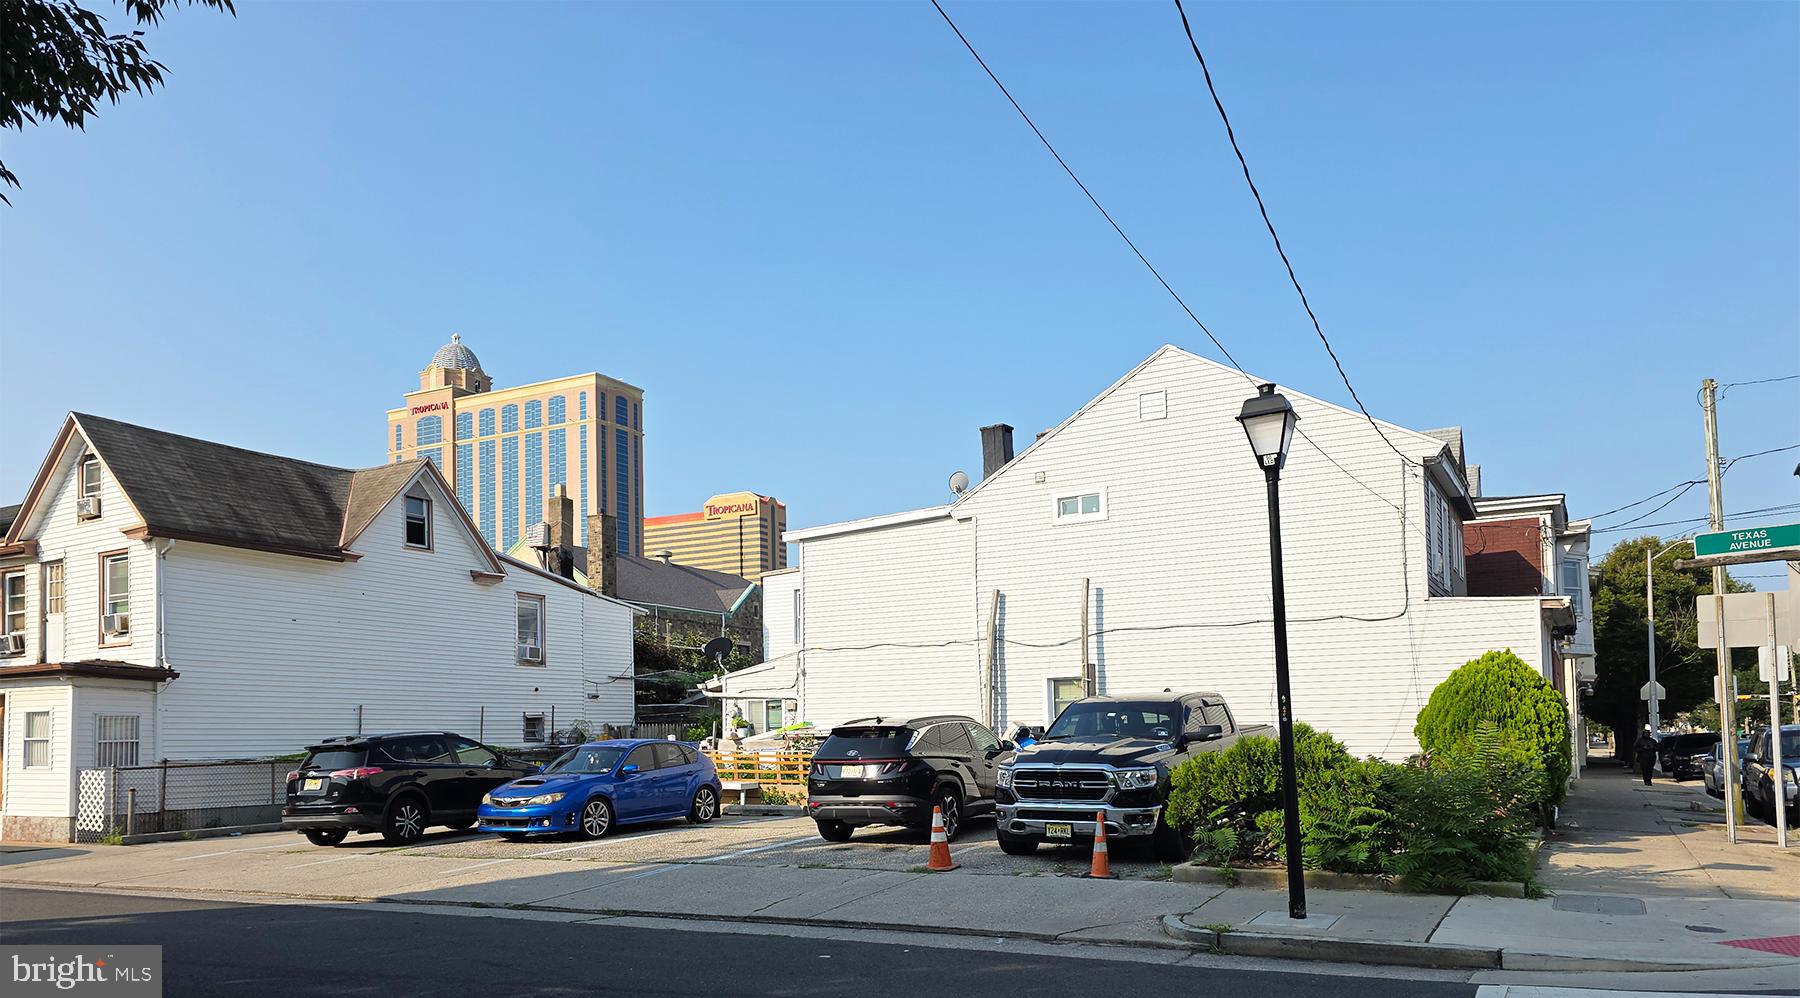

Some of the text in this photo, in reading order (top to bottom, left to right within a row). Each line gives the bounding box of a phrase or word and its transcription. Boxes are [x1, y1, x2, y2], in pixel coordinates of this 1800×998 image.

[410, 402, 449, 415] TROPICANA
[706, 503, 754, 516] TROPICANA
[1731, 530, 1767, 541] TEXAS
[1729, 539, 1772, 551] AVENUE
[1038, 780, 1078, 788] RAM
